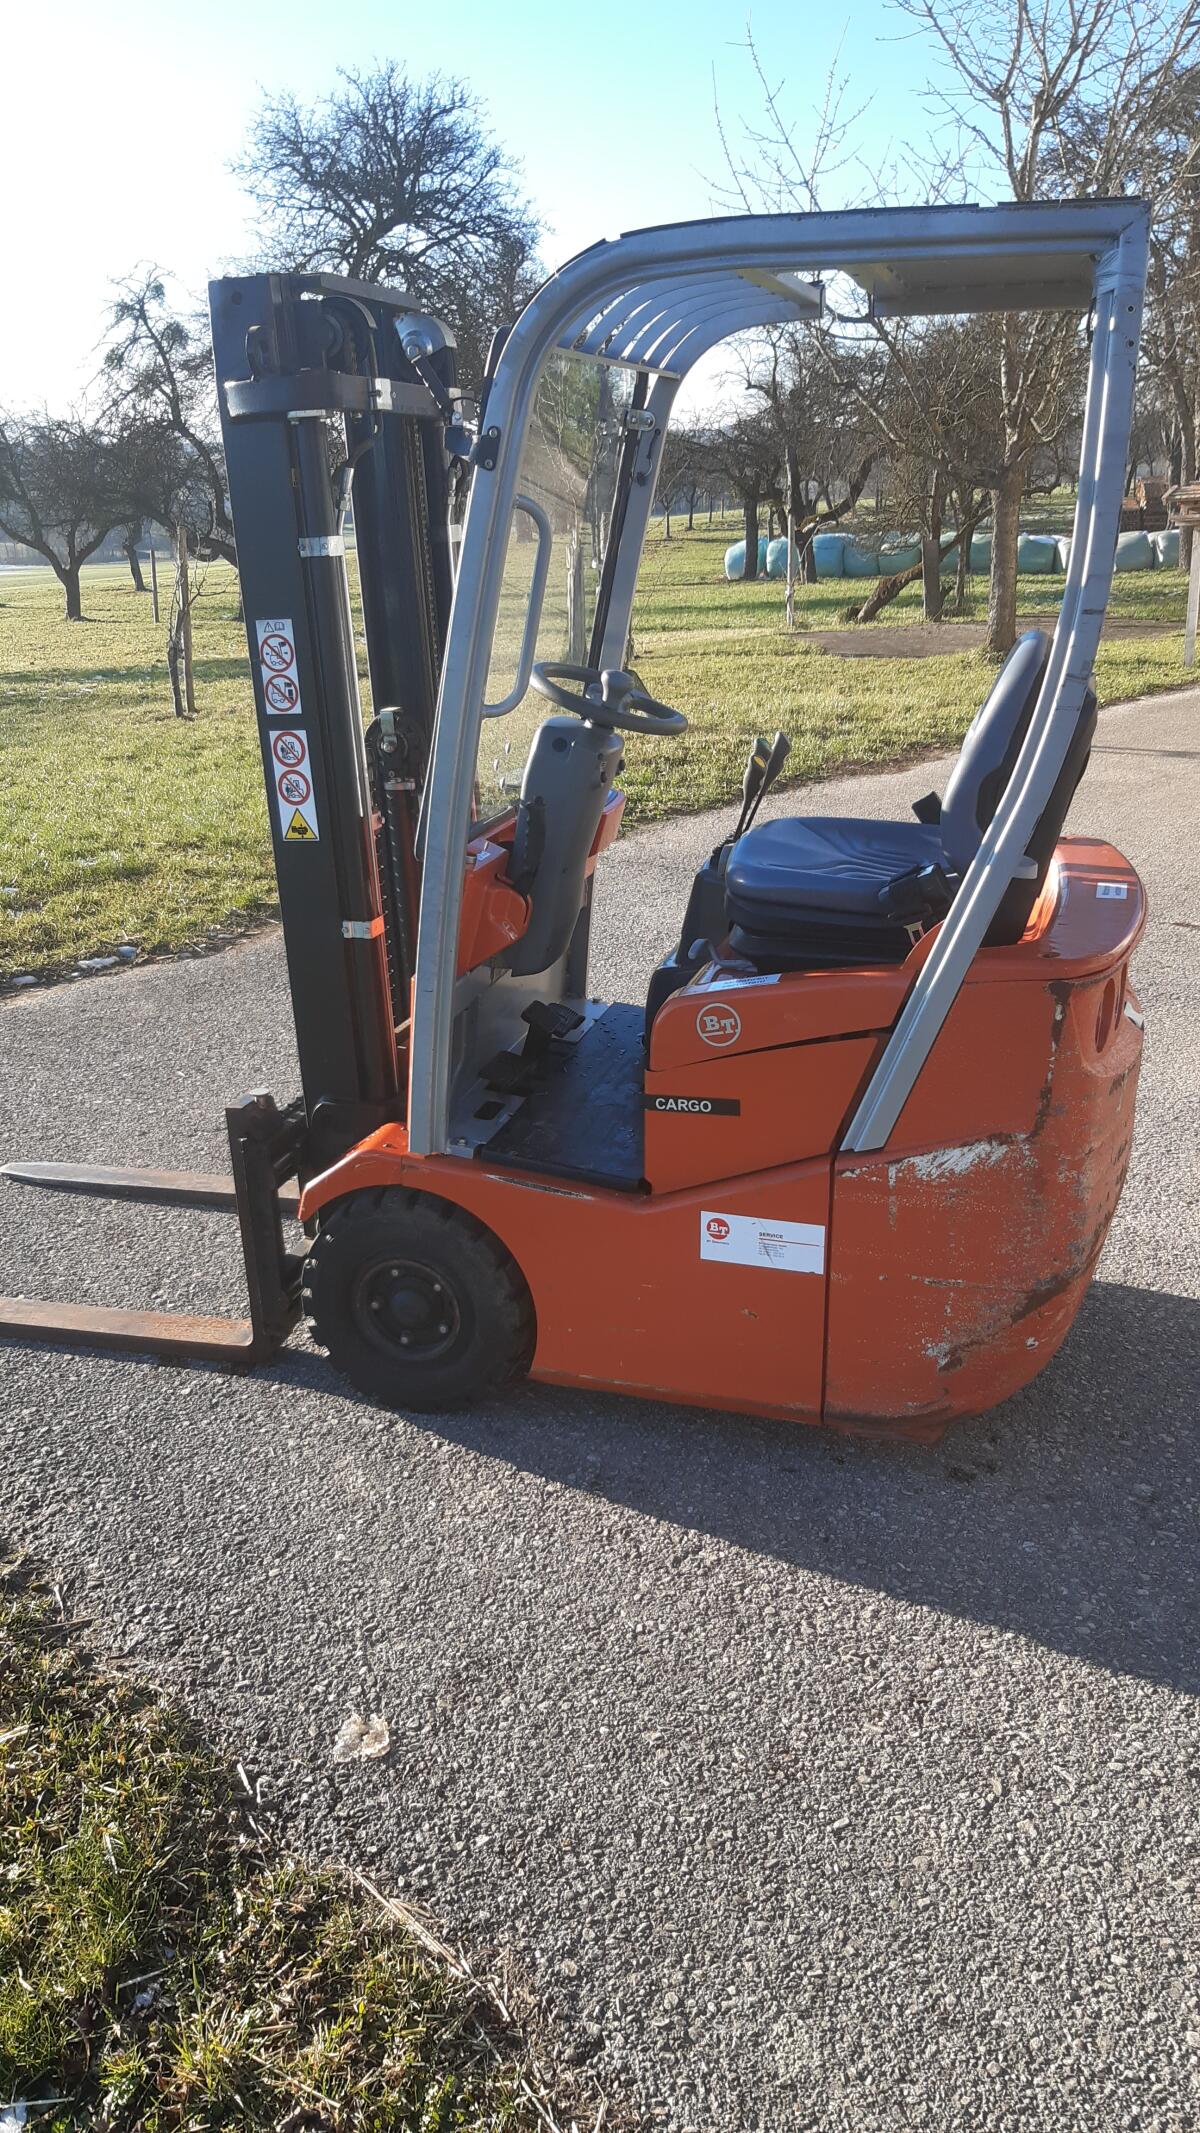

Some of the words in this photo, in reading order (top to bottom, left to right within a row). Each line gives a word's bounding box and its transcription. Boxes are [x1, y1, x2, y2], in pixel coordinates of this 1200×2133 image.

[703, 1015, 735, 1034] BT
[655, 1098, 712, 1112] CARGO
[709, 1222, 728, 1235] BT
[758, 1231, 784, 1239] SERVICE
